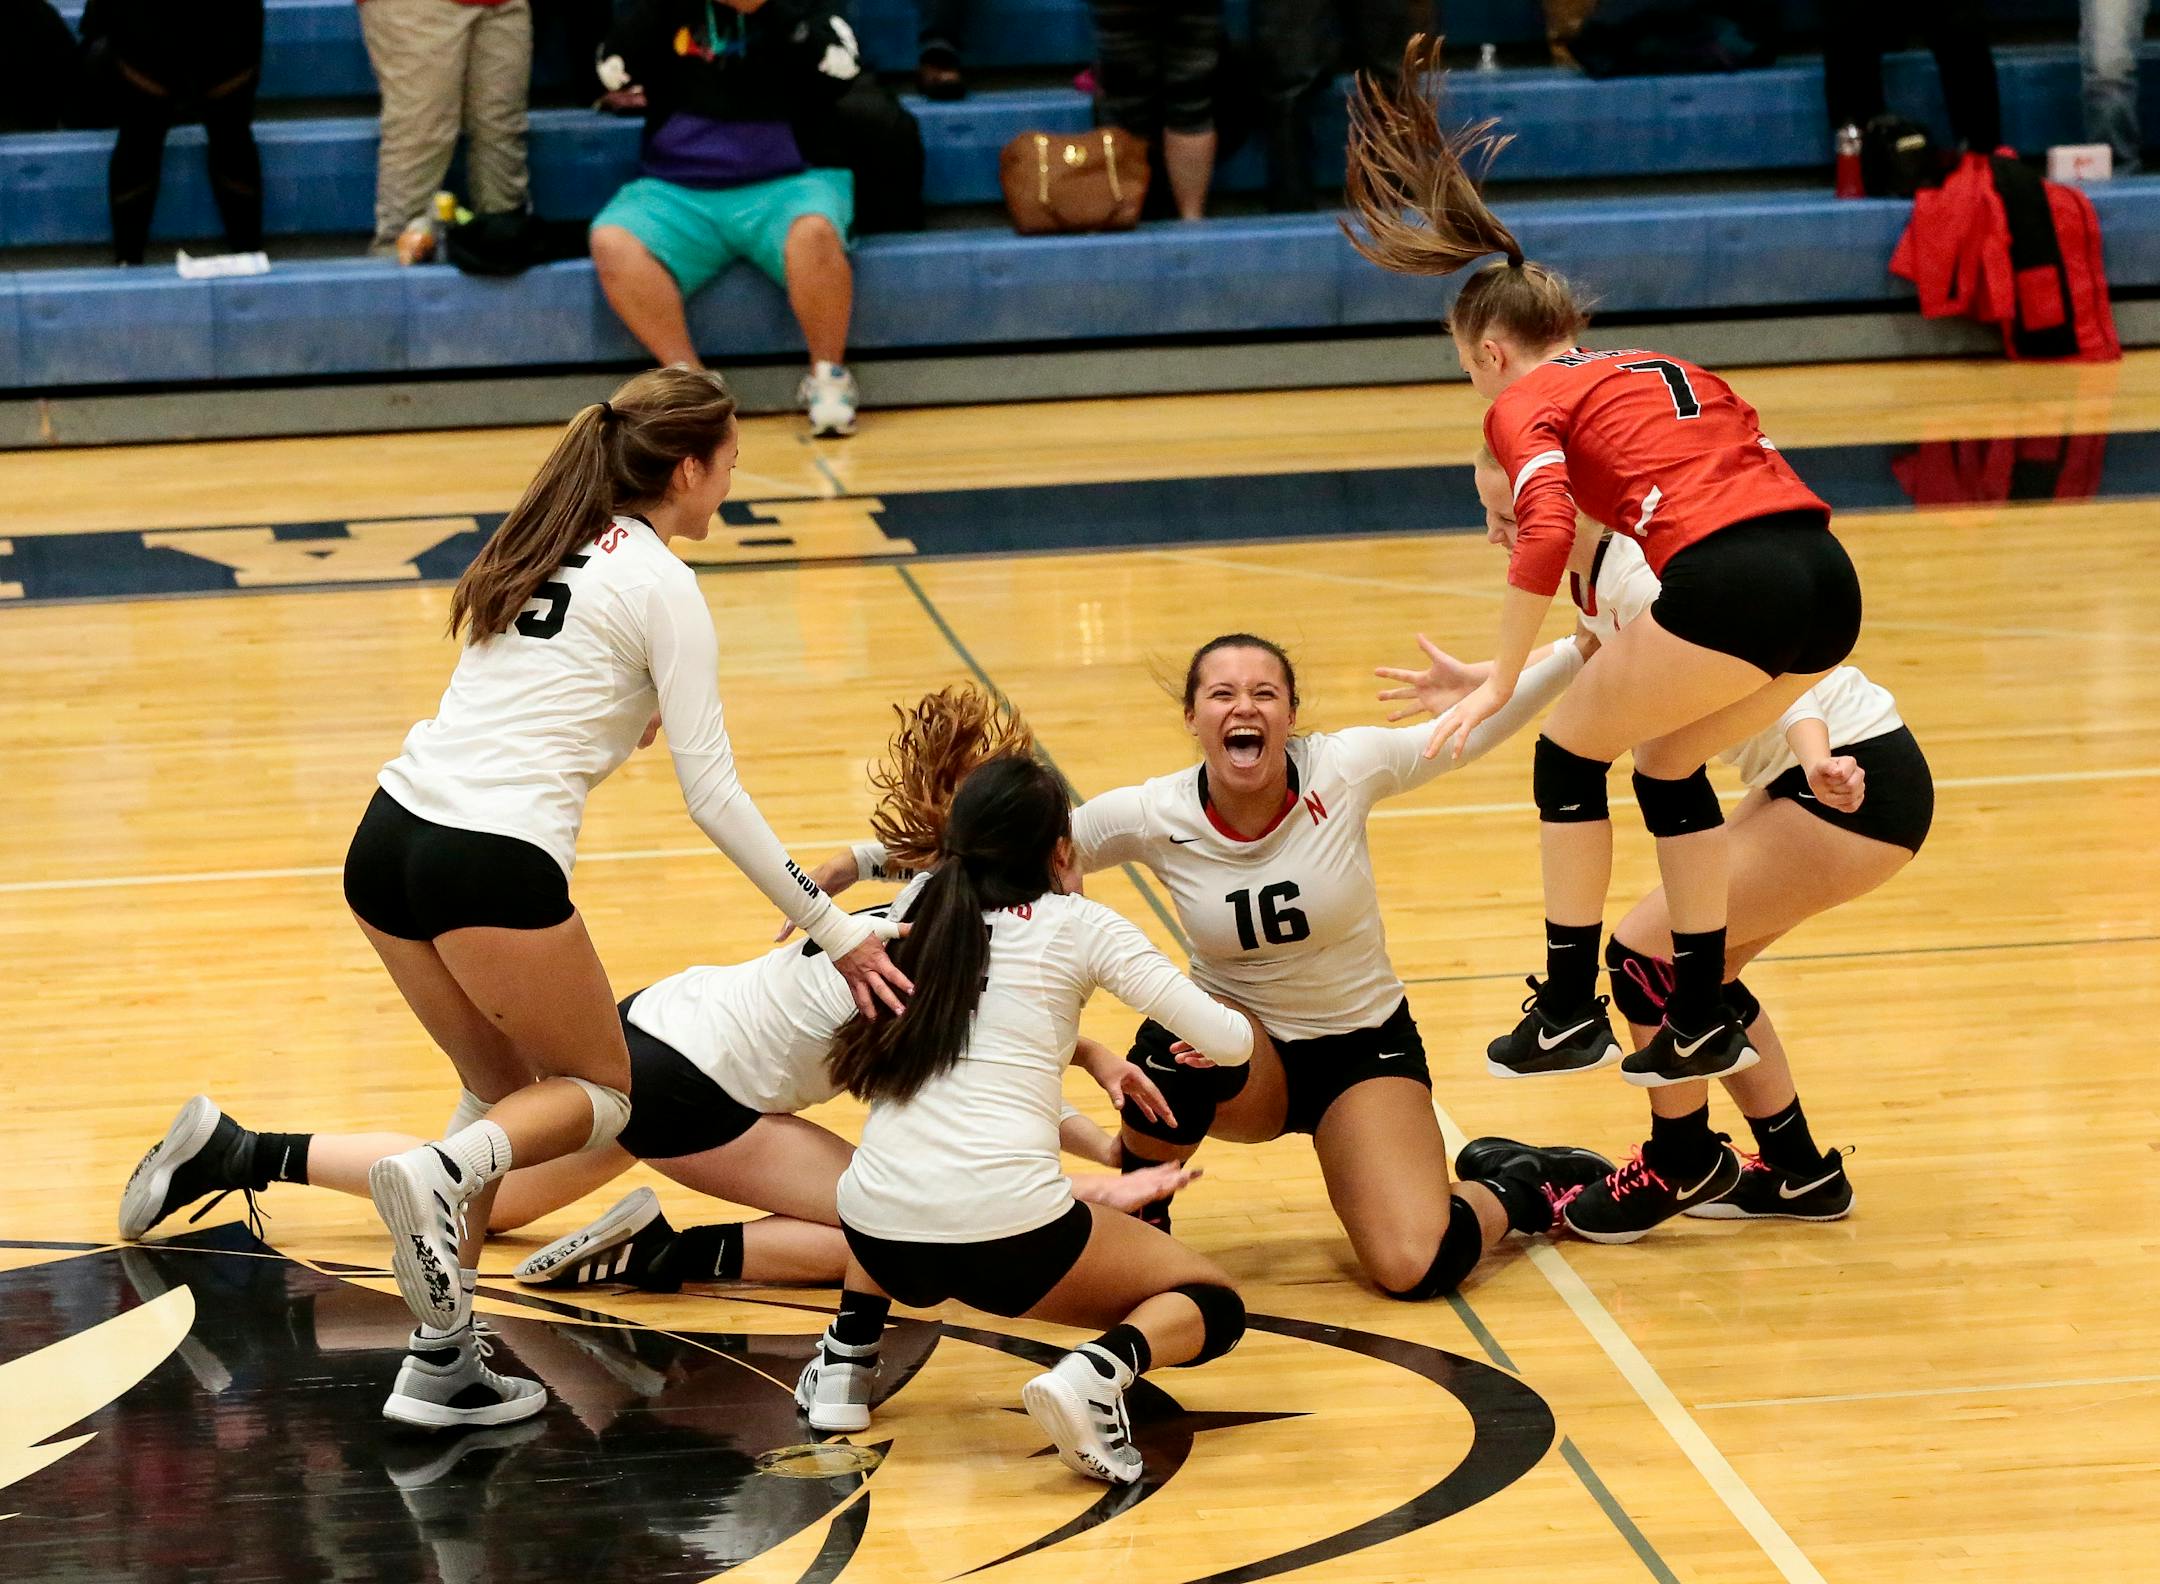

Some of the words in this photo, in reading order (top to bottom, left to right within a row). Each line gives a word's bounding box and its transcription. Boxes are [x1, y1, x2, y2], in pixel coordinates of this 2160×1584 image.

[1615, 358, 1701, 420] 7
[1303, 790, 1328, 826] N
[1225, 880, 1311, 951] 16
